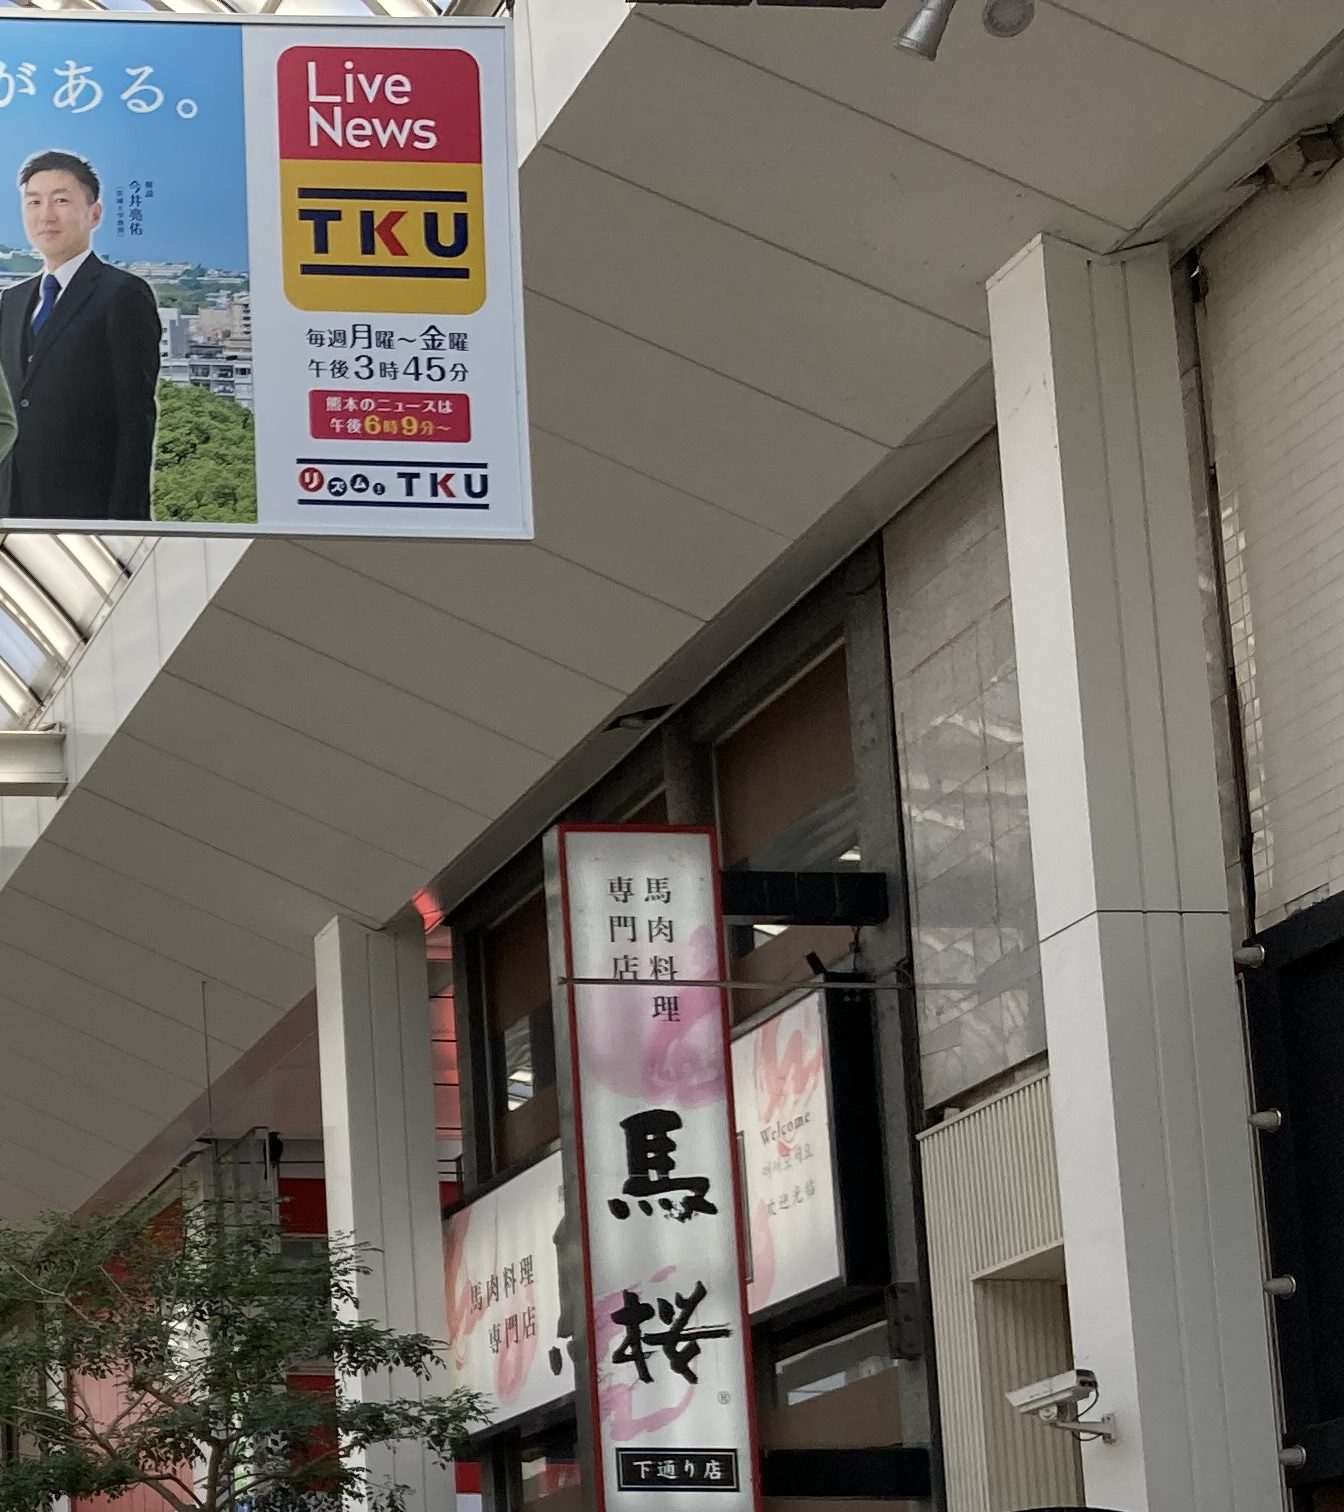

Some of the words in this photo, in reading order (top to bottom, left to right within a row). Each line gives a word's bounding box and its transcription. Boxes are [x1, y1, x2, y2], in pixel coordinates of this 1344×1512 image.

[307, 61, 413, 106] Live
[308, 106, 439, 150] News
[297, 209, 470, 259] TKU
[307, 354, 470, 382] 午後3時45分
[325, 396, 454, 415] 熊本のニュースは
[397, 472, 490, 499] TKU
[607, 876, 641, 981] 専門店
[643, 876, 681, 1025] 馬肉料理
[760, 1111, 811, 1144] Welcome
[607, 1108, 734, 1384] 馬桜
[469, 1253, 535, 1314] 馬肉料理
[487, 1304, 538, 1358] 専門店
[631, 1459, 724, 1482] 下通り店
